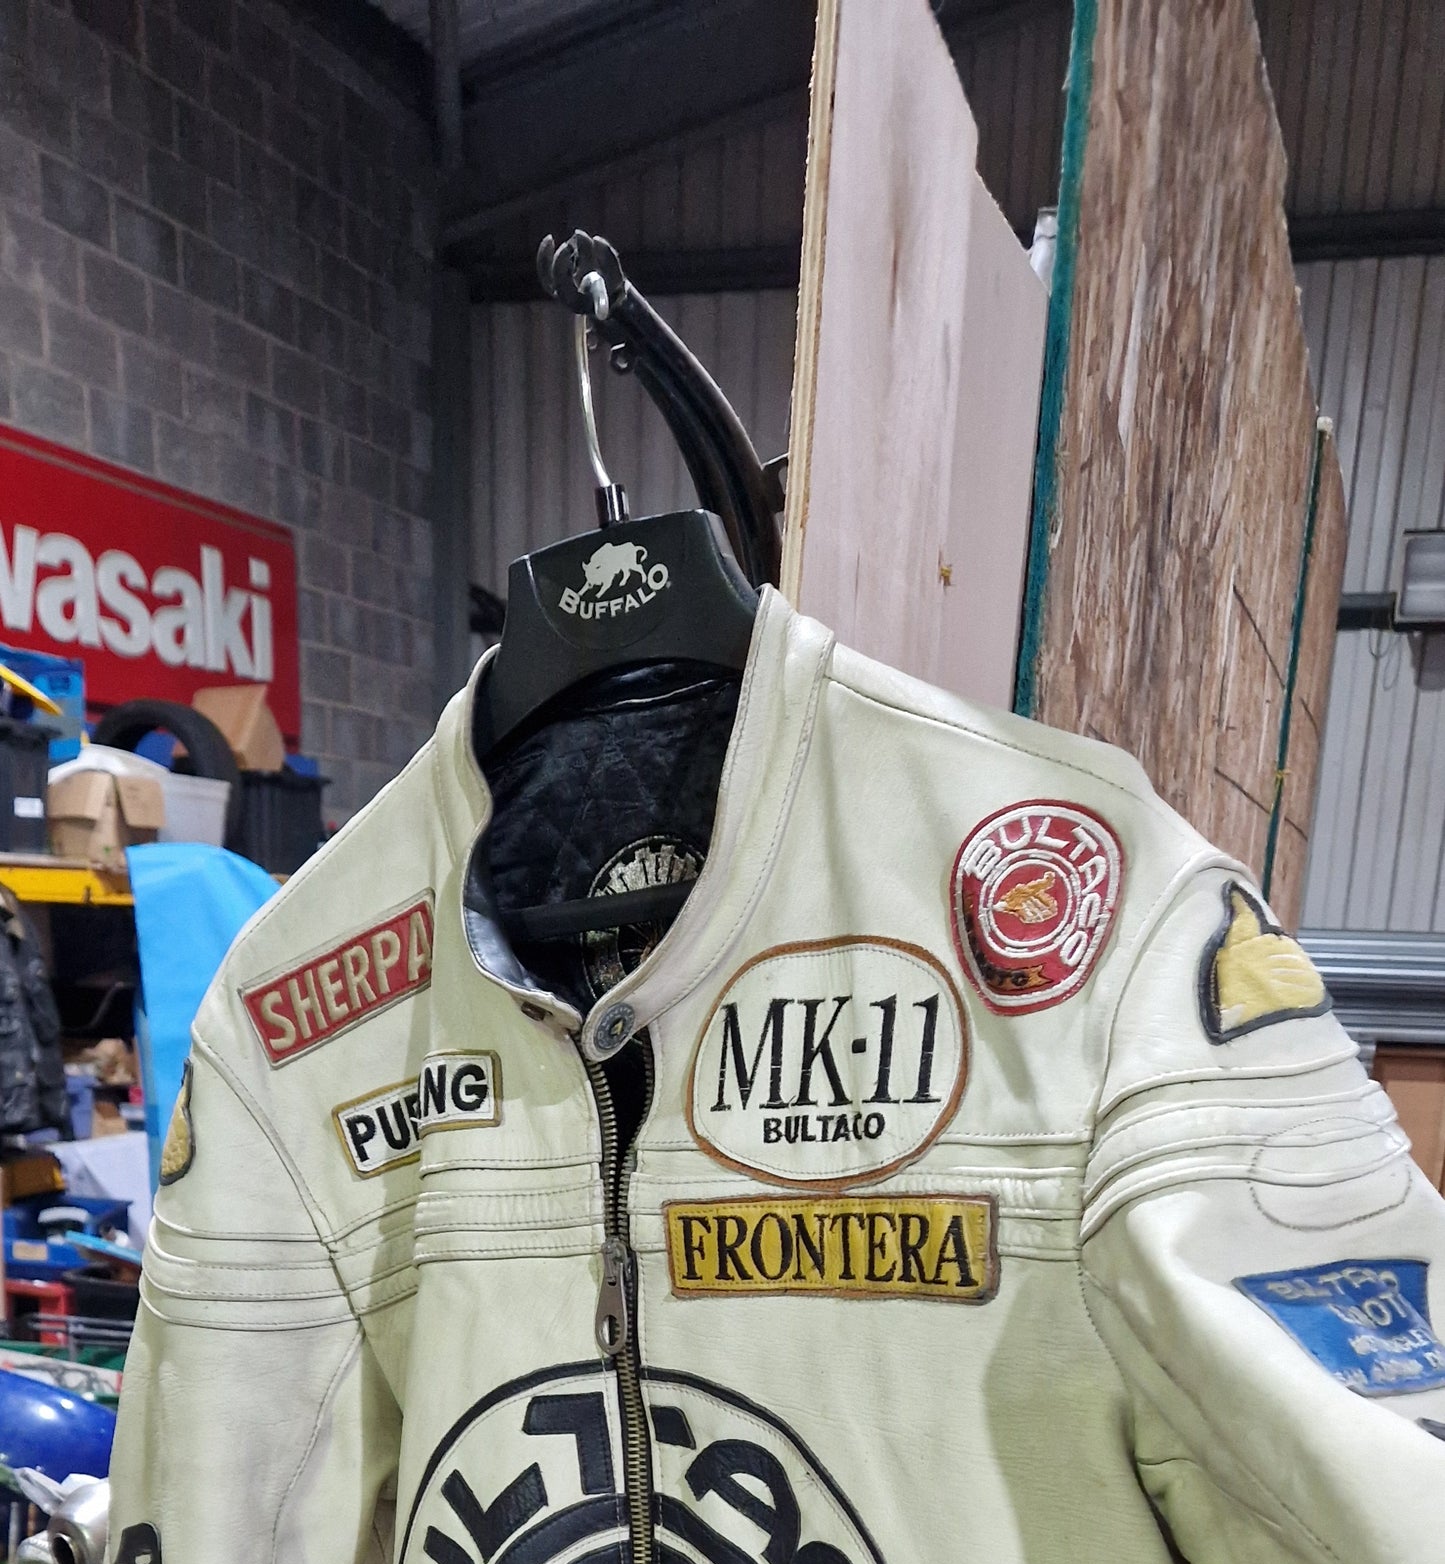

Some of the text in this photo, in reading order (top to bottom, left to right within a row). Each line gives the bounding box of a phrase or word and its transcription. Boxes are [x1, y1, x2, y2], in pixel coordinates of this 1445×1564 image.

[558, 563, 669, 620] BUFFALO
[964, 816, 1108, 968] BULTACO
[260, 910, 433, 1050] SHERPA
[763, 1111, 886, 1144] BULTACO
[676, 1211, 981, 1288] FRONTERA
